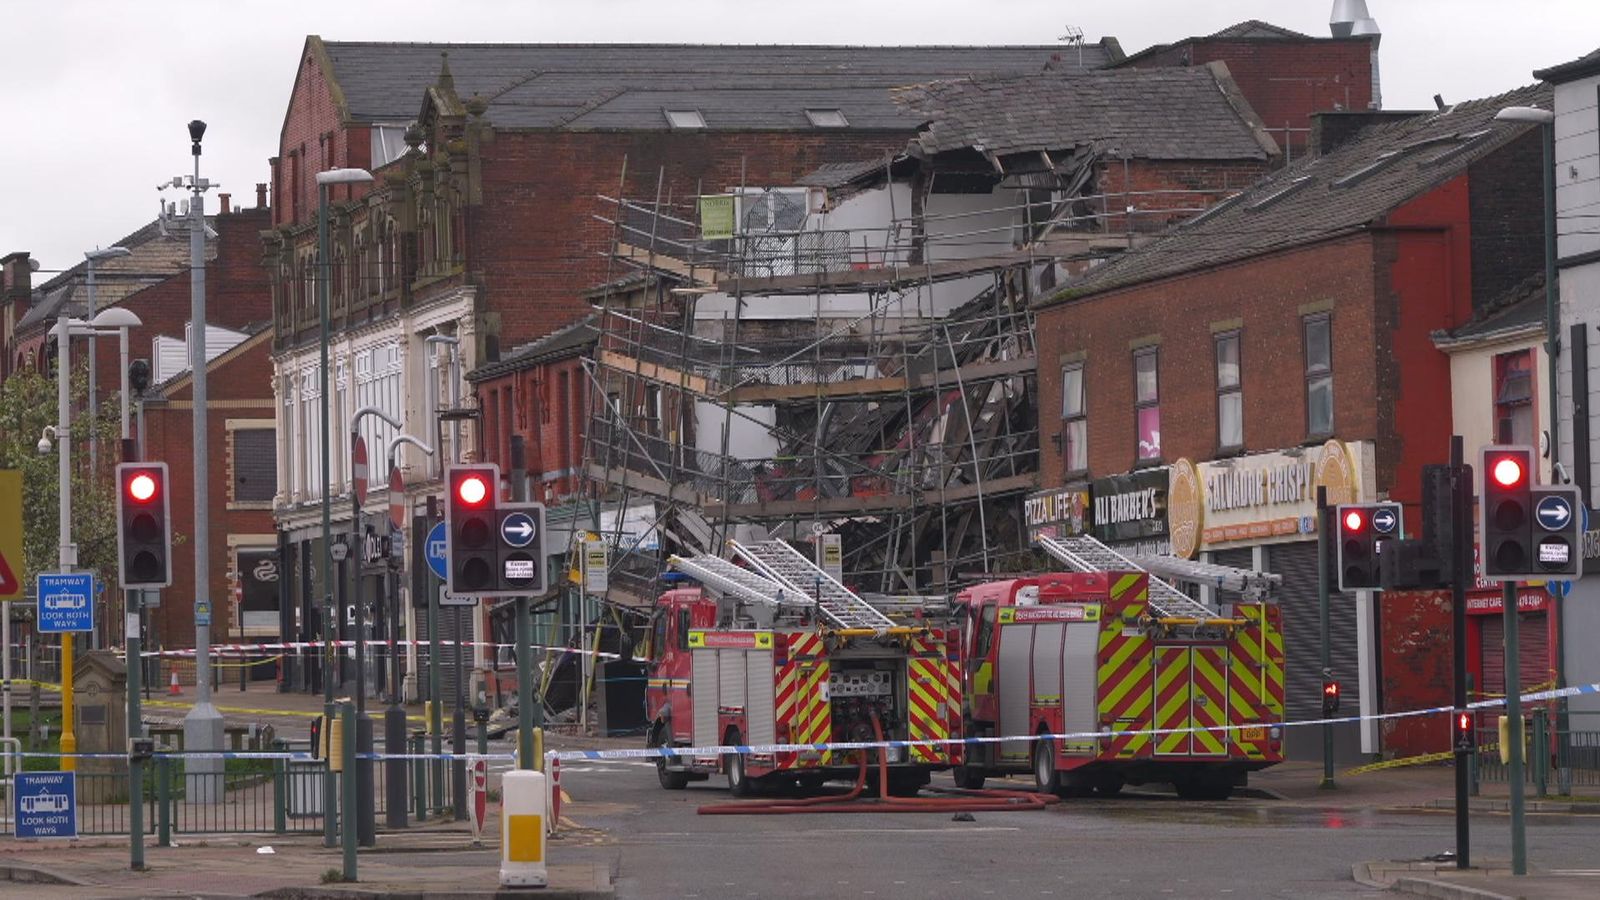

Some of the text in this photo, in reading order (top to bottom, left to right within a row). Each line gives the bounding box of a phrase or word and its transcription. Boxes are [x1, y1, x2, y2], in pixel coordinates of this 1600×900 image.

[1206, 469, 1267, 512] SALVADOR
[1269, 462, 1315, 503] CRISPY
[1024, 492, 1070, 527] PIZZA LIFE
[1095, 487, 1156, 526] ALI BARBER'S
[44, 578, 86, 586] TRAMWAY
[41, 611, 89, 620] LOOK BOTH
[54, 620, 78, 628] WAYS
[24, 776, 64, 785] TRAMWAY
[22, 816, 68, 826] LOOK BOTH
[34, 827, 57, 836] WAYS
